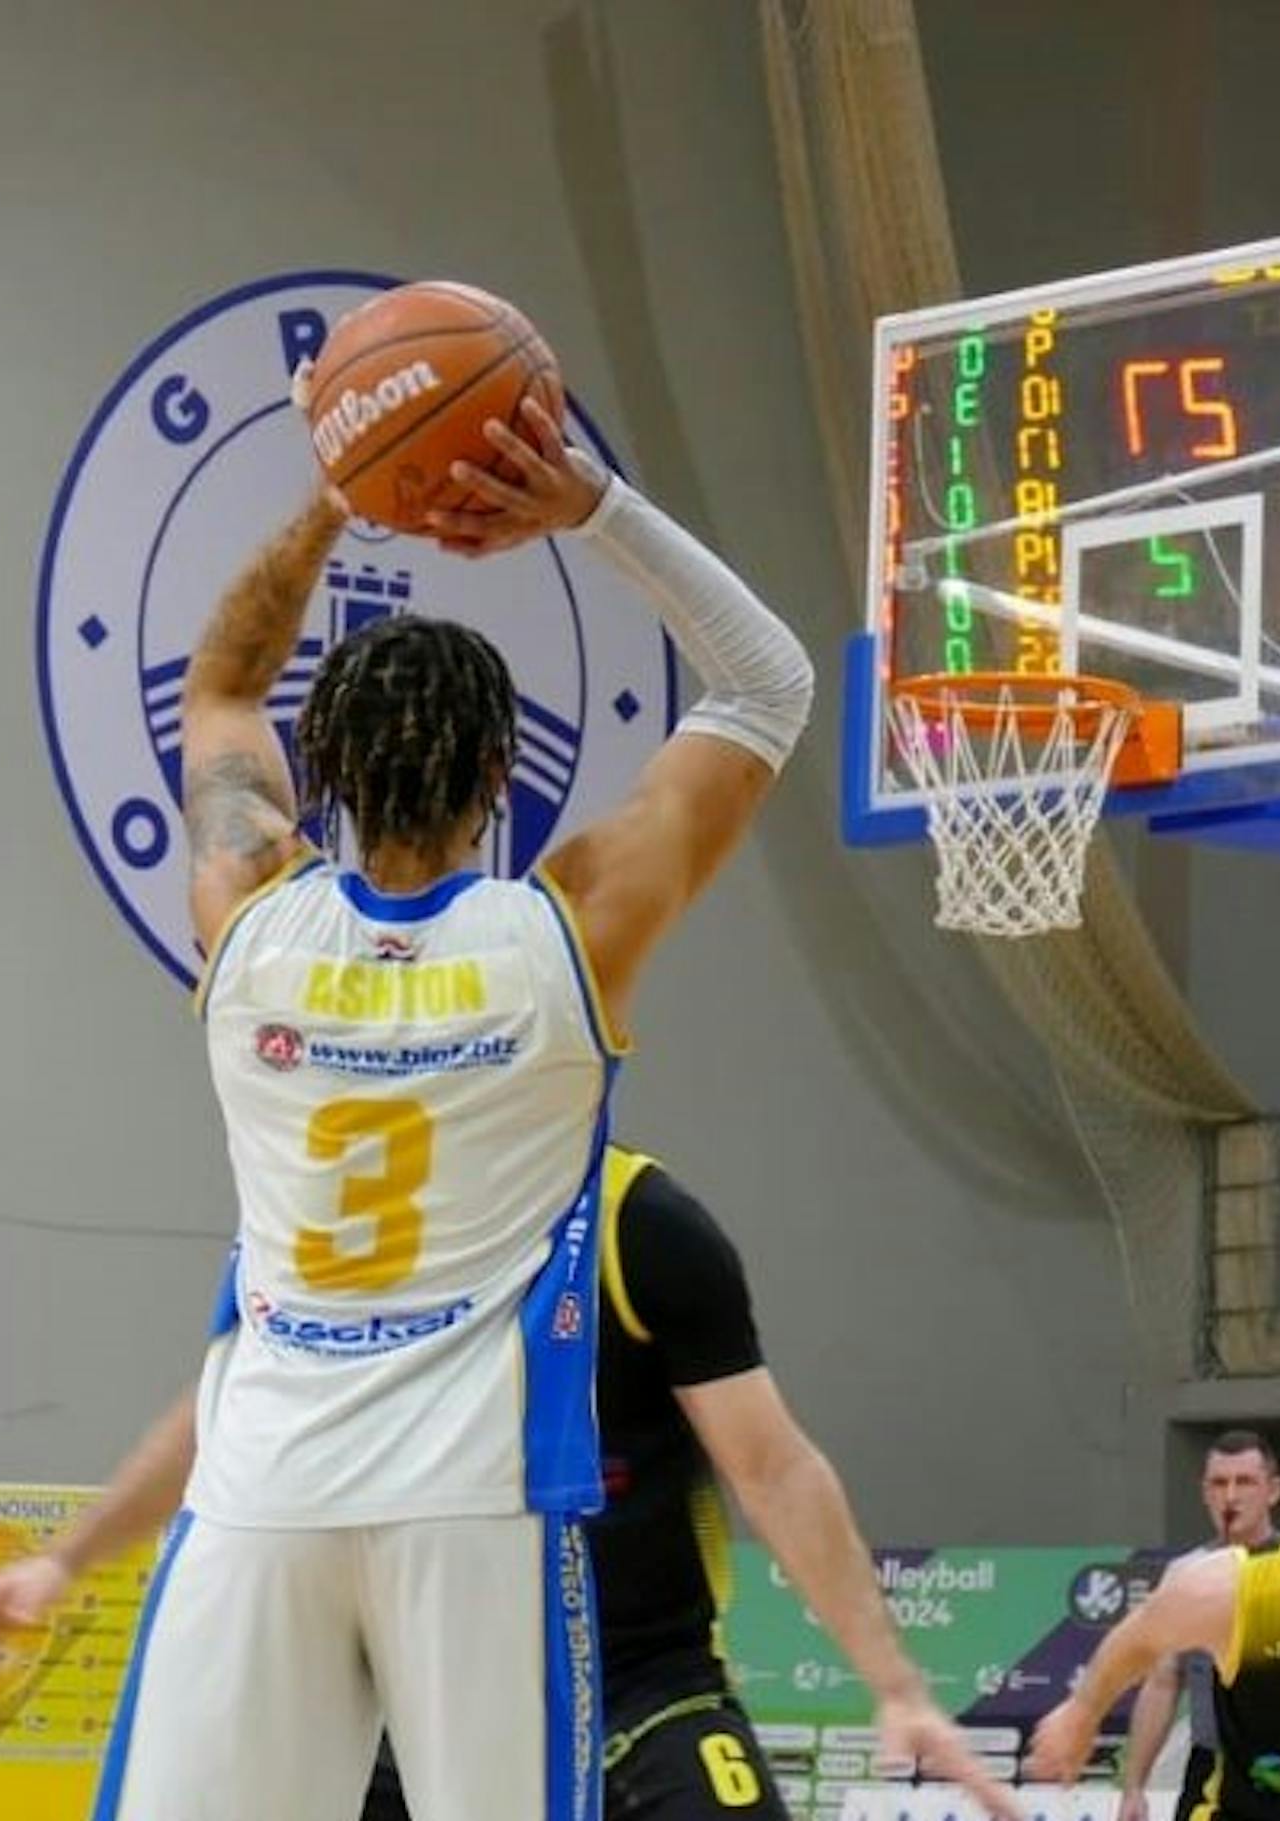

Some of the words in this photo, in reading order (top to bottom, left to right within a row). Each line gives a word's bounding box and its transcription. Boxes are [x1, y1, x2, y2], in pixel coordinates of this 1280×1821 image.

[313, 360, 442, 466] Wilson
[301, 958, 488, 1024] ASHTON
[292, 1096, 438, 1292] 3
[874, 1558, 996, 1600] lleyball
[698, 1730, 763, 1808] 6
